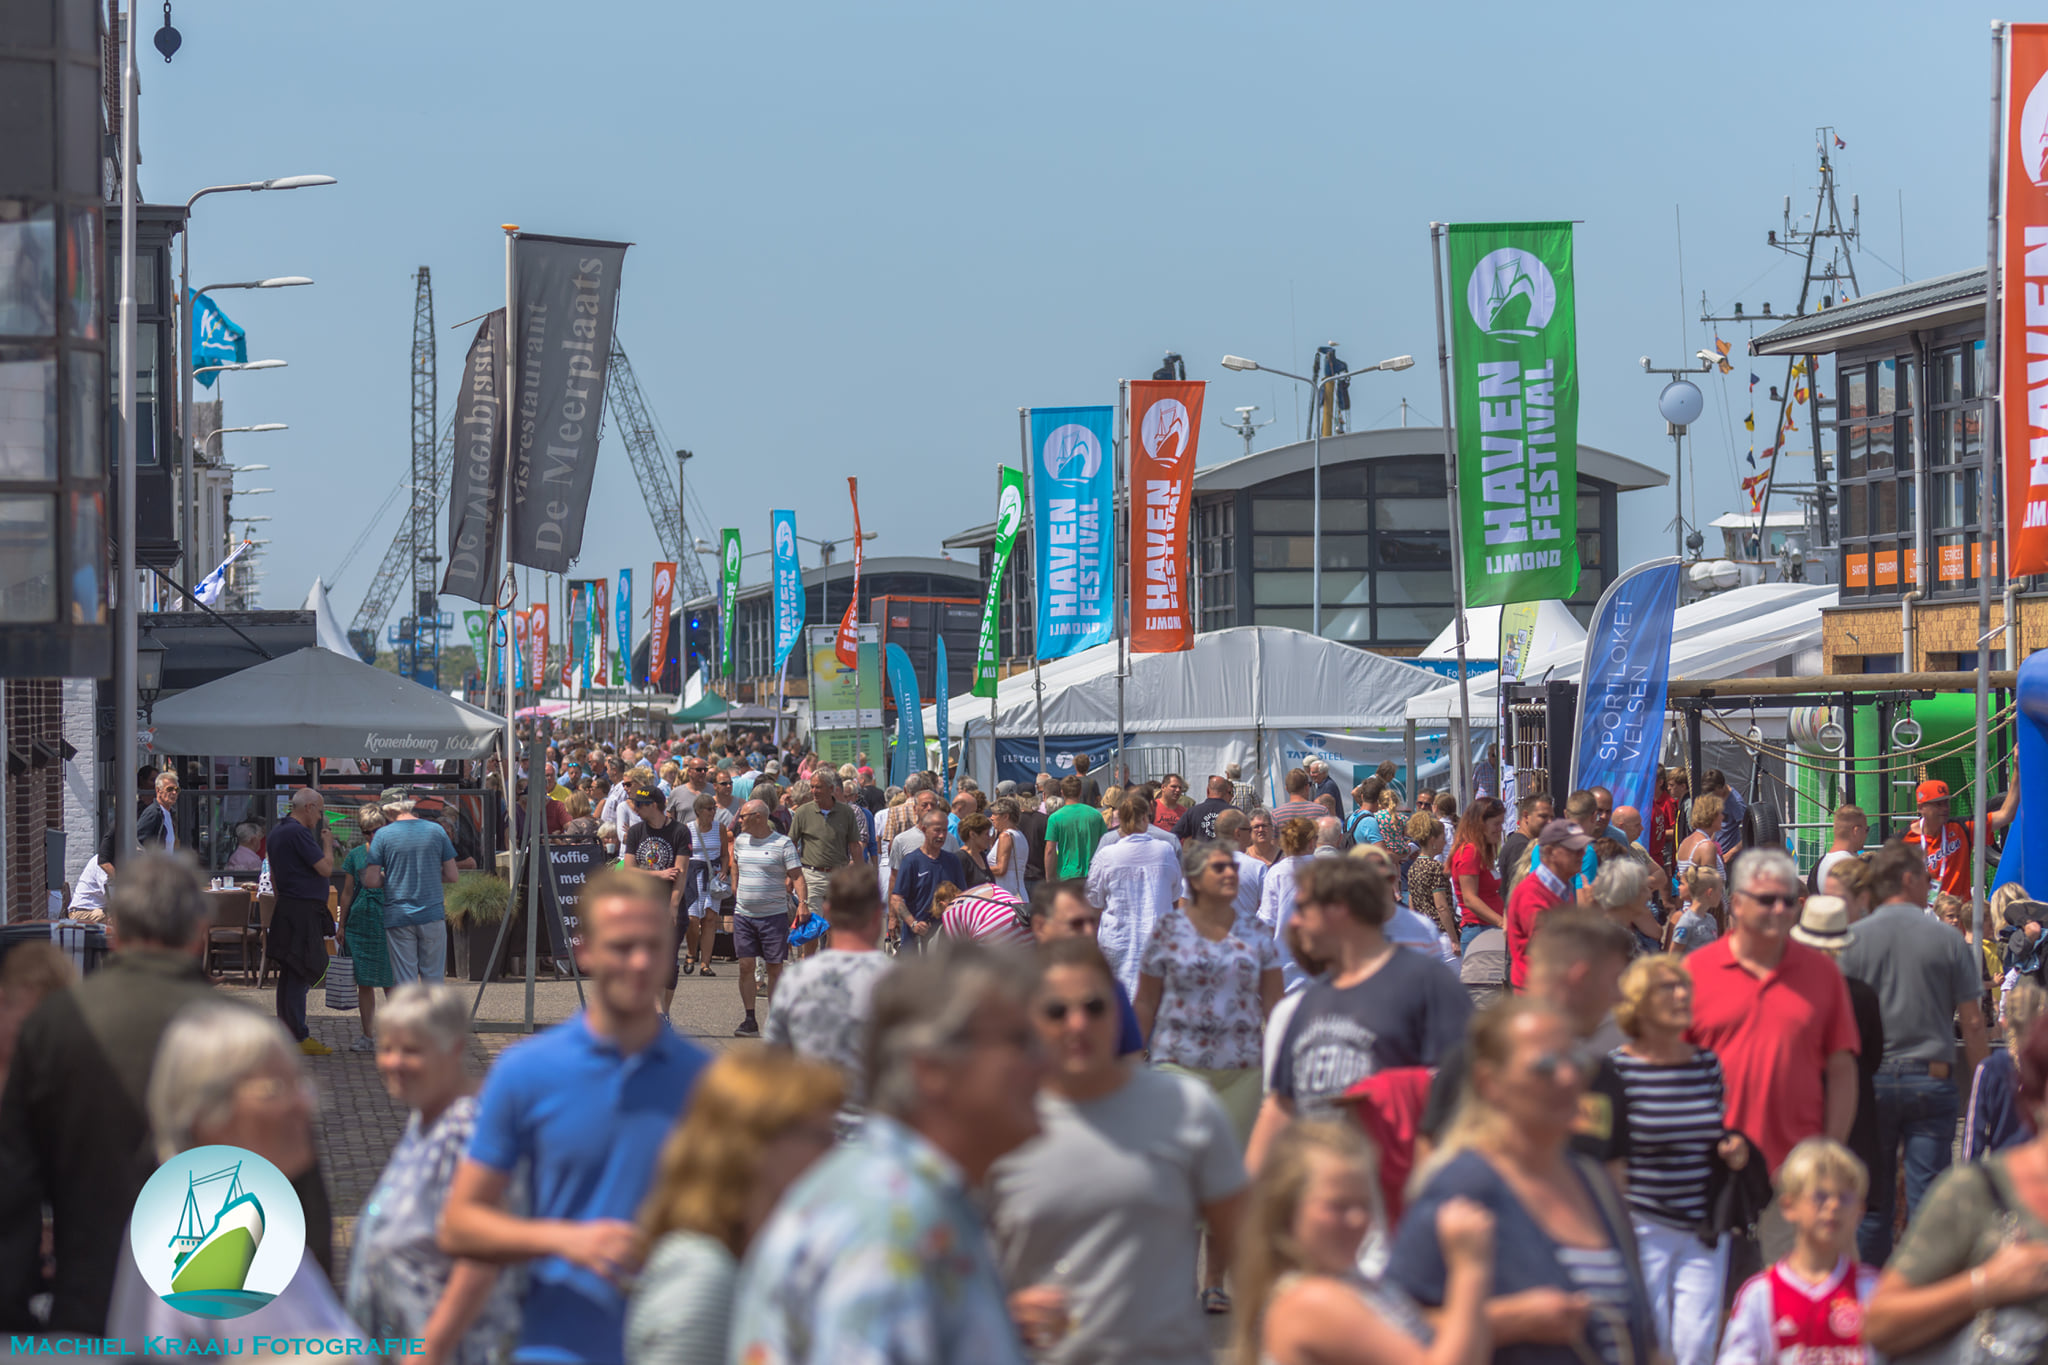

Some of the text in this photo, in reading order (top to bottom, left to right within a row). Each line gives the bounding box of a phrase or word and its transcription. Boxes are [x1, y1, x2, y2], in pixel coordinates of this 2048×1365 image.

[515, 301, 548, 505] visrestaurant
[535, 257, 603, 555] De Meerplaats
[1478, 360, 1528, 546] HAVEN
[1525, 358, 1561, 541] FESTIVAL
[1050, 499, 1078, 617] HAVEN
[1079, 498, 1101, 616] FESTIVAL
[1146, 480, 1171, 609] HAVEN
[1164, 480, 1182, 608] FESTIVAL
[1486, 549, 1561, 575] IJMOND
[1050, 621, 1100, 636] IJMOND
[1600, 596, 1633, 760] SPORTLOKET
[364, 732, 480, 753] Kronenbourg 1664
[1002, 754, 1052, 764] FLETCHR
[1318, 751, 1344, 761] STEEL
[1622, 665, 1649, 761] VELSEN
[550, 851, 590, 864] Koffie
[560, 872, 586, 884] met
